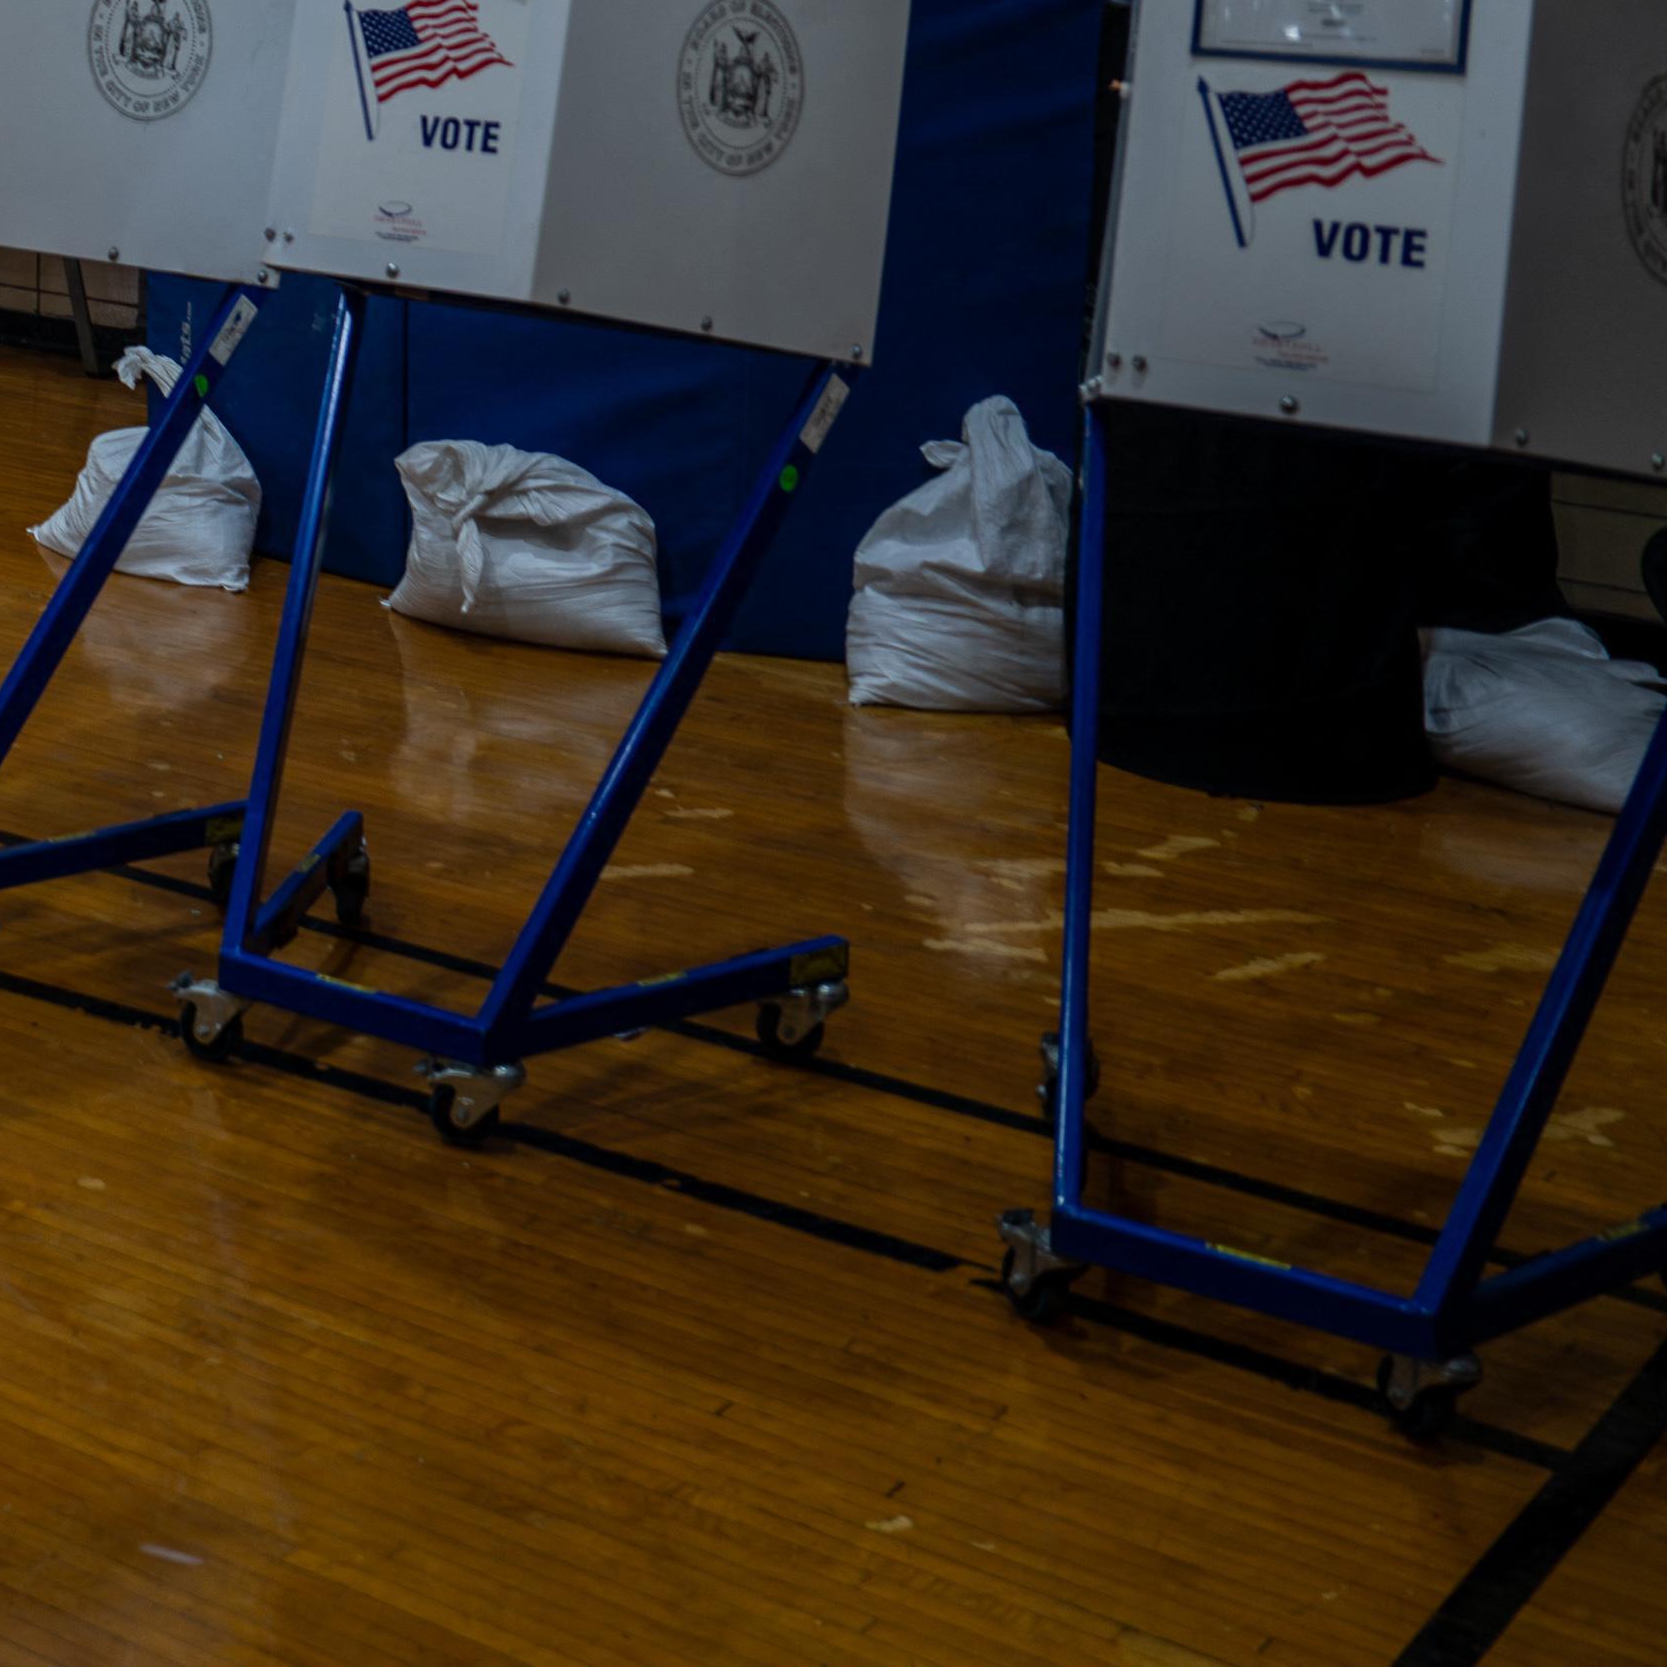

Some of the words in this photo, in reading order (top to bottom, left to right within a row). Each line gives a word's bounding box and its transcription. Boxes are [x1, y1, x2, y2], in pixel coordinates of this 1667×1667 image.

[93, 24, 103, 42] IN
[94, 45, 108, 76] THE
[181, 54, 205, 92] YORK
[105, 80, 132, 107] CITY
[132, 101, 150, 112] OF
[153, 92, 180, 113] NEW
[420, 114, 501, 154] VOTE
[1313, 218, 1428, 270] VOTE
